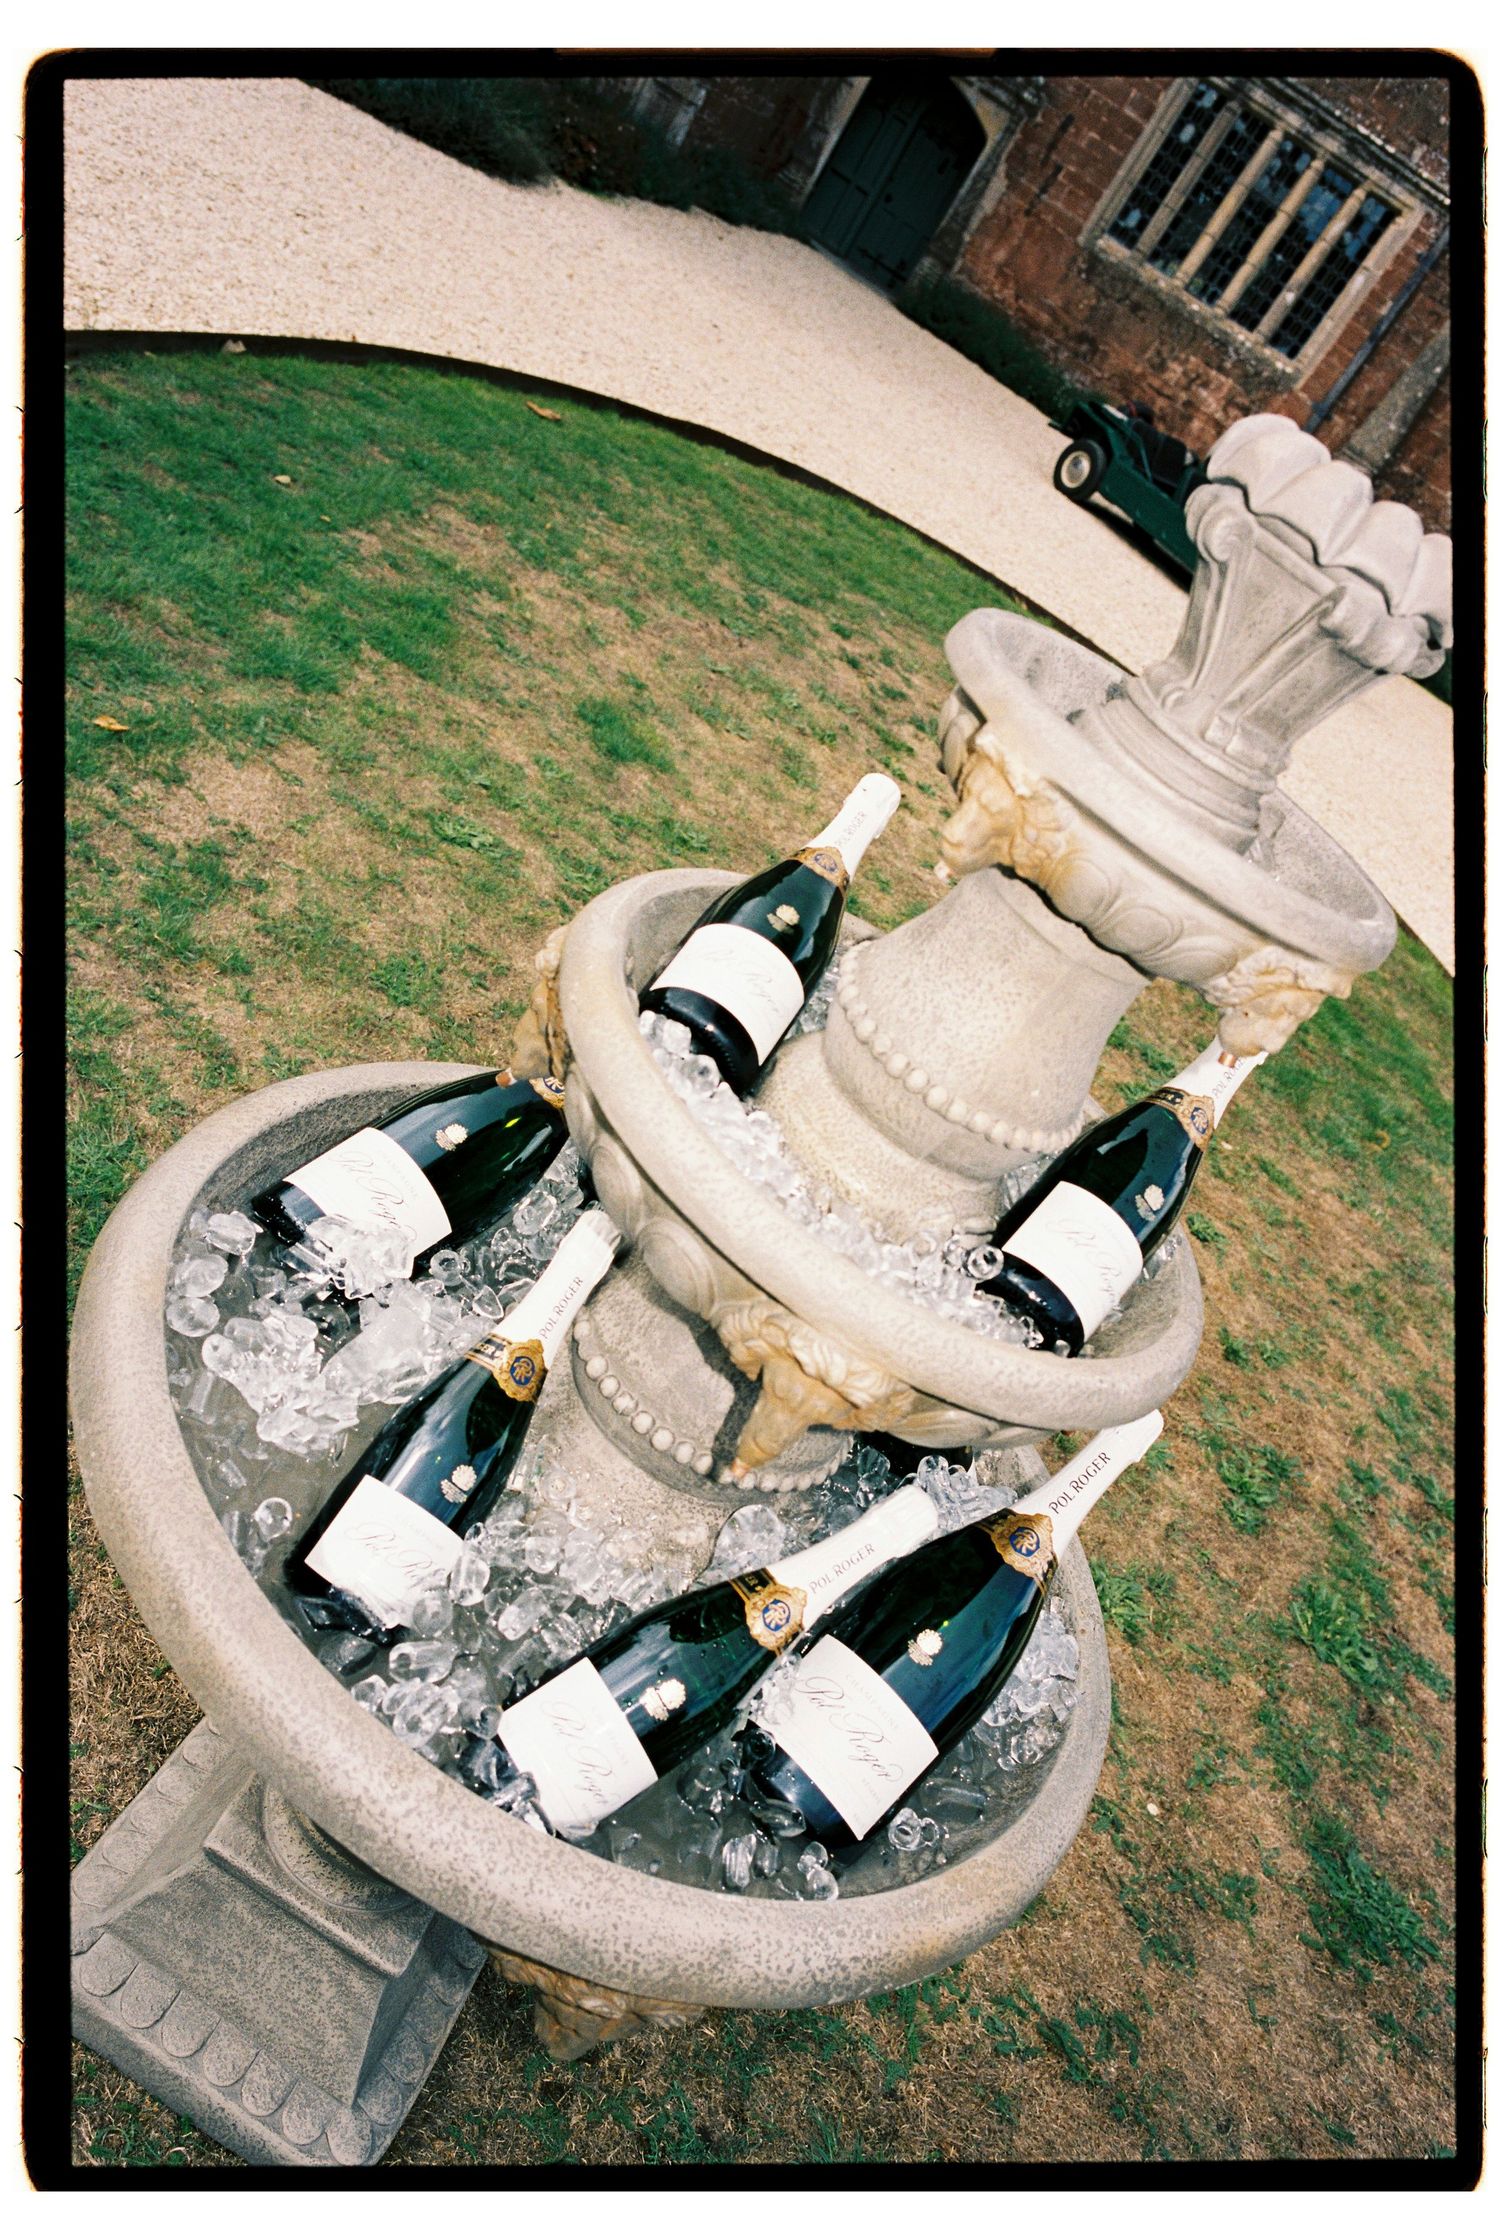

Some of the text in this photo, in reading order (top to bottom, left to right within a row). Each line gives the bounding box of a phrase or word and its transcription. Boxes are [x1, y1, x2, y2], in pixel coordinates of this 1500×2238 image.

[539, 1275, 584, 1340] POL ROGER
[1048, 1452, 1112, 1514] POL ROGER
[808, 1543, 876, 1594] POL ROGER
[794, 1676, 904, 1782] Pol Roger
